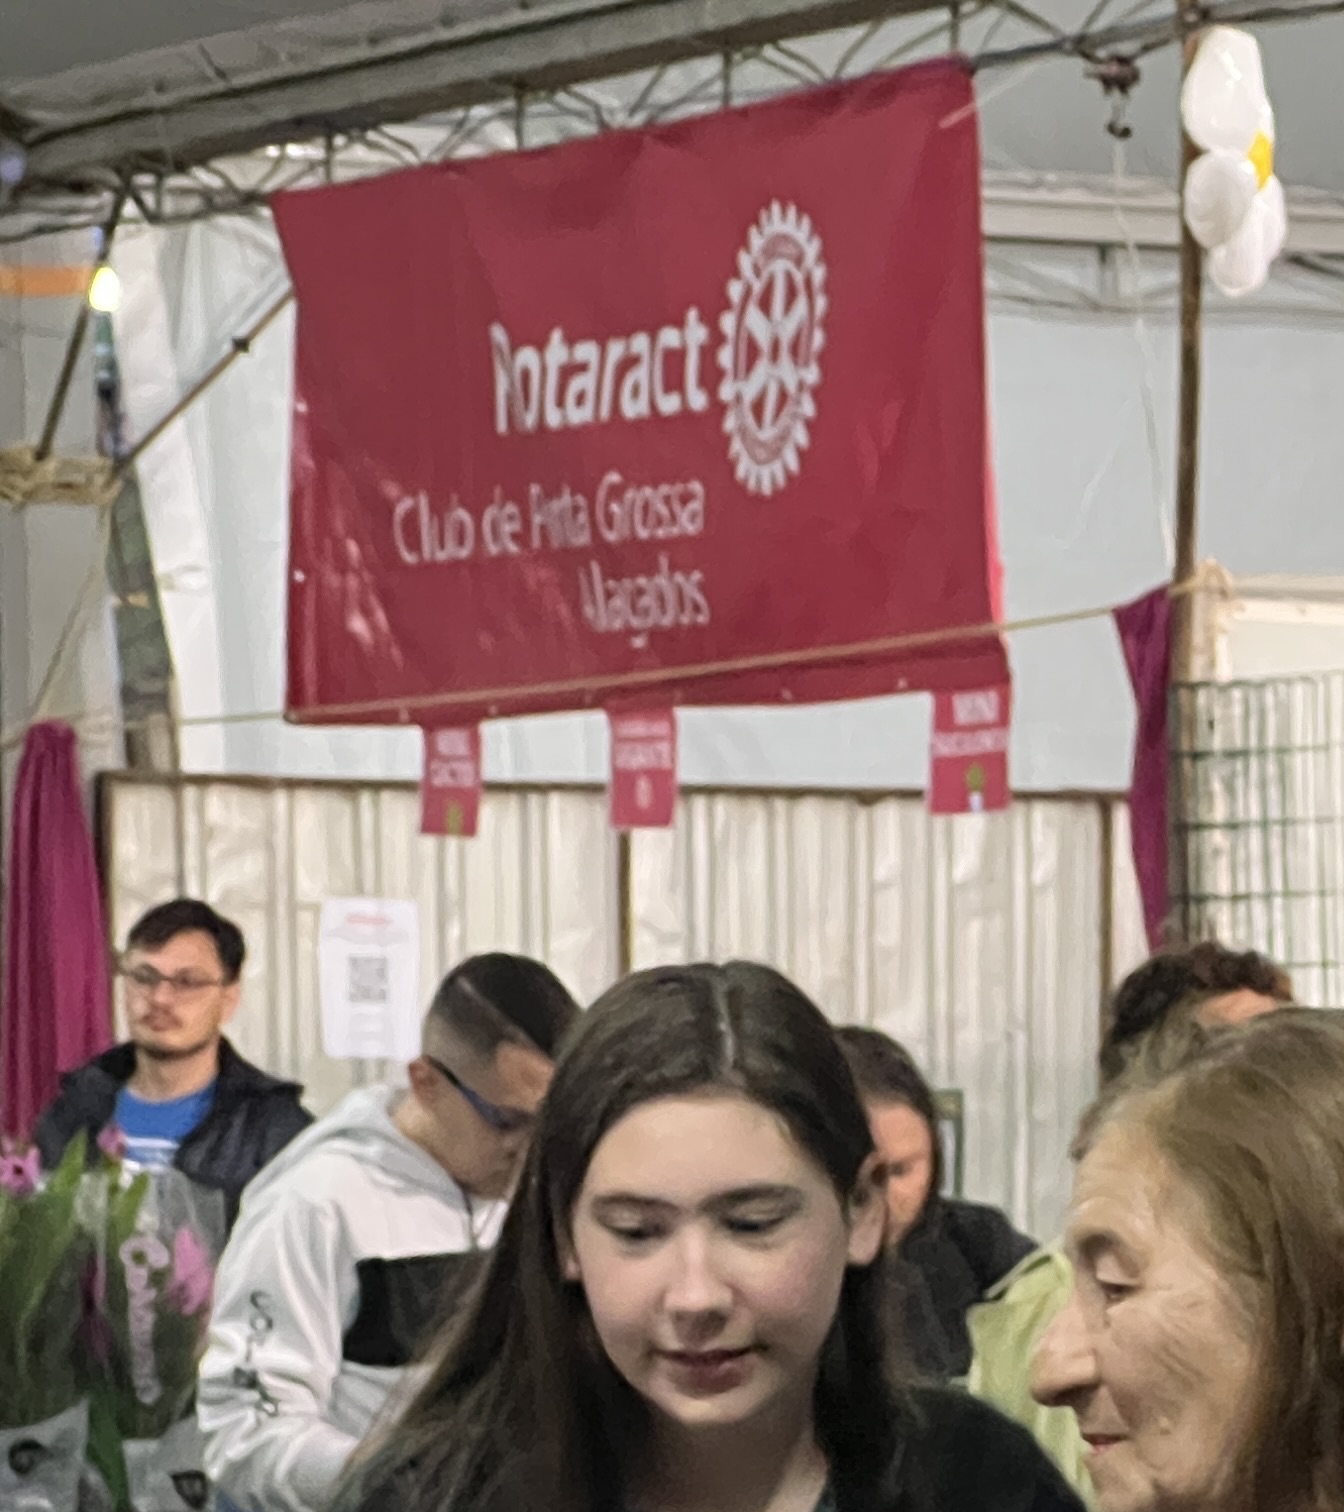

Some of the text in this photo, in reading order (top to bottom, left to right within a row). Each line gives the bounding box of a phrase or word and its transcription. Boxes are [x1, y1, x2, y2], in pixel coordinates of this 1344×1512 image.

[393, 489, 475, 564] Club
[482, 484, 523, 556] de
[596, 470, 705, 543] Grossa
